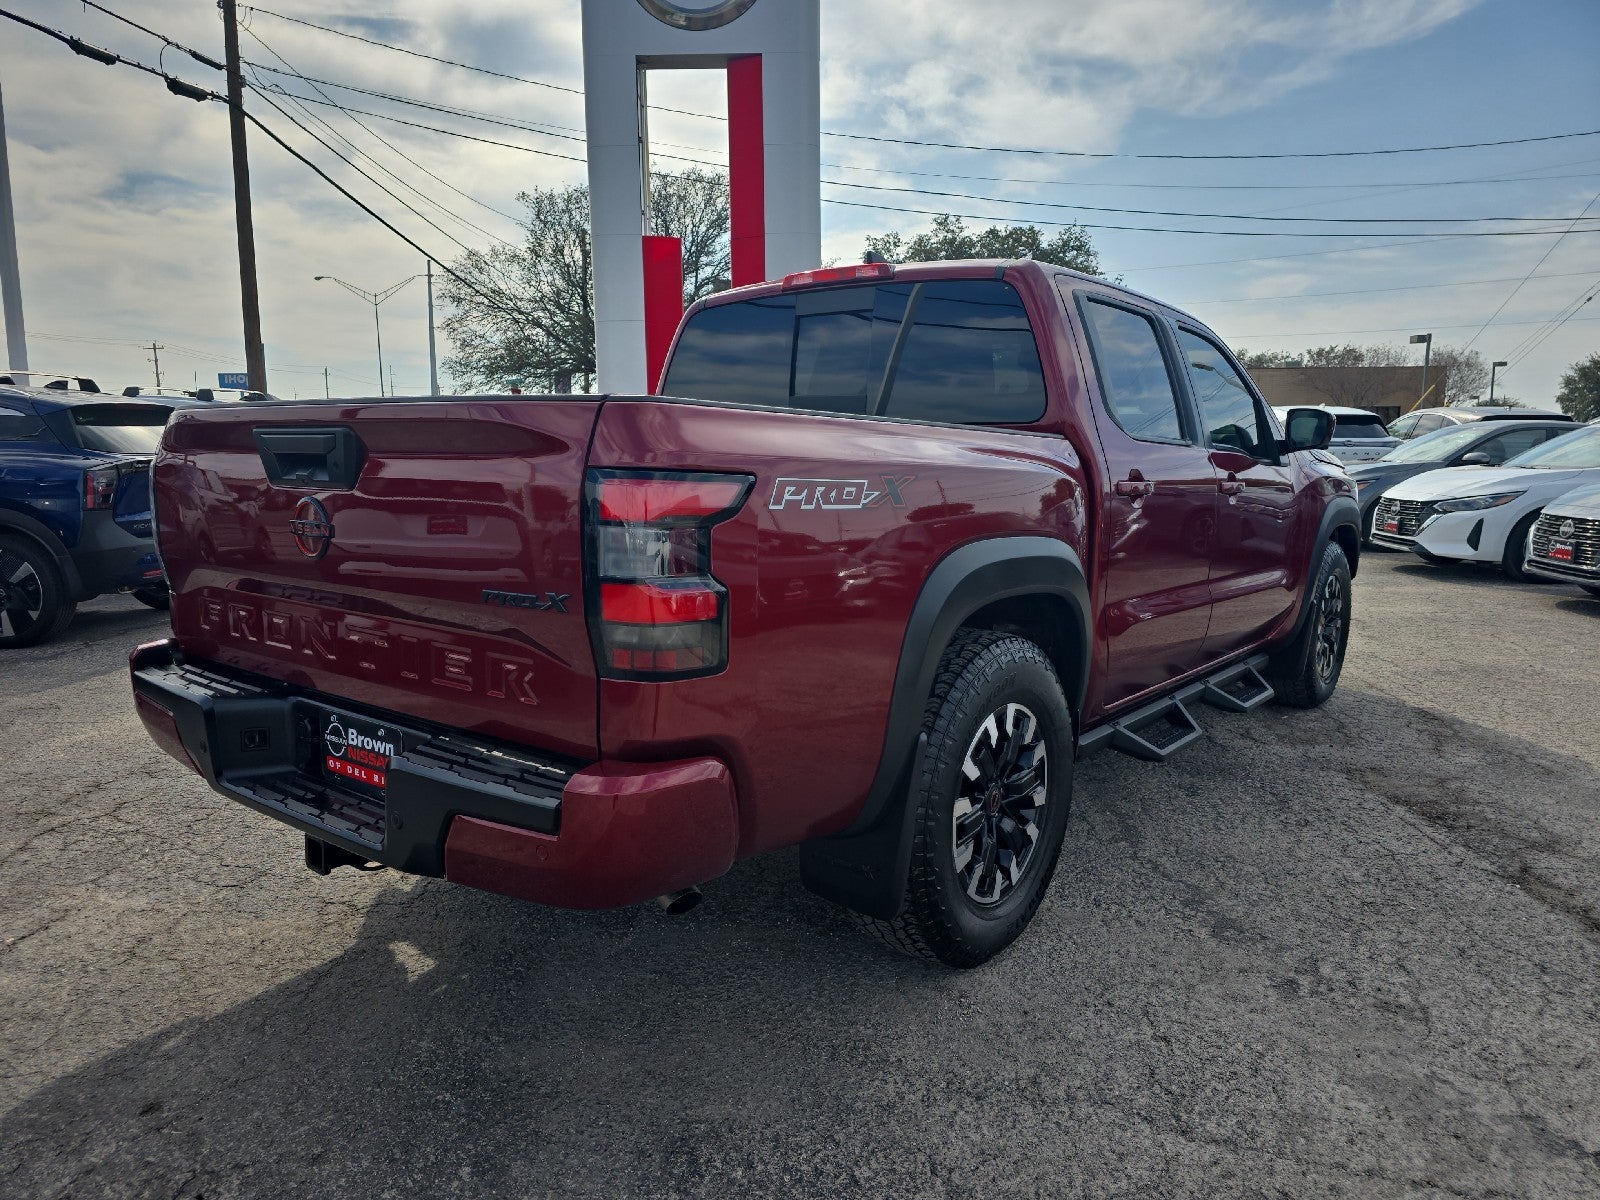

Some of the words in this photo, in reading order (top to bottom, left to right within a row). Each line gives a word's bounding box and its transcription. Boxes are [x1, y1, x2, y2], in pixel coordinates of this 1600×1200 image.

[224, 374, 249, 384] IHO
[200, 594, 541, 706] FRONTIER
[324, 734, 347, 745] NISSAN
[348, 728, 394, 756] Brown
[329, 760, 341, 770] OF
[347, 766, 366, 778] DEL
[373, 774, 385, 784] RI
